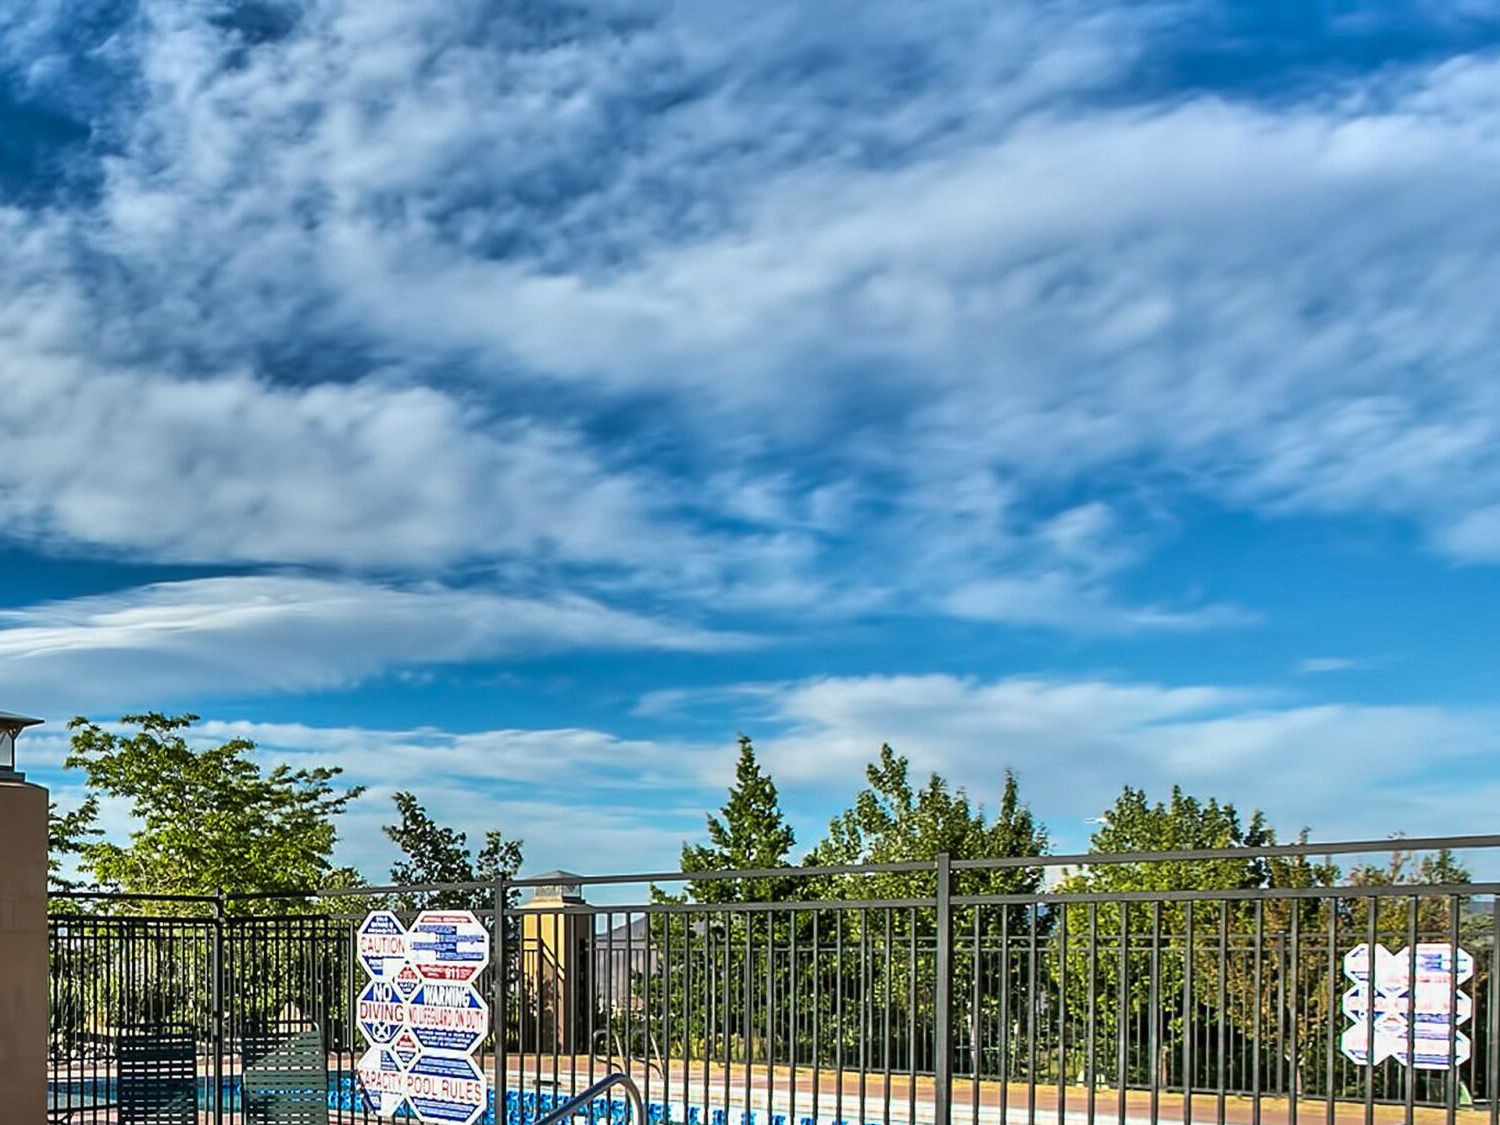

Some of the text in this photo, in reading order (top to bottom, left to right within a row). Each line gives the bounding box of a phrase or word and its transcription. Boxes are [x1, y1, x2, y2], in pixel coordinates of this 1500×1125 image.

[359, 936, 406, 954] CAUTION
[445, 967, 459, 979] 911
[373, 982, 393, 1002] NO
[424, 984, 470, 1008] WARNING
[360, 1002, 404, 1022] DIVING
[408, 1007, 417, 1024] NO
[419, 1007, 453, 1026] LIFEGUARD
[455, 1010, 465, 1027] ON
[357, 1070, 401, 1090] CAPACITY
[407, 1075, 482, 1102] POOL RULES
